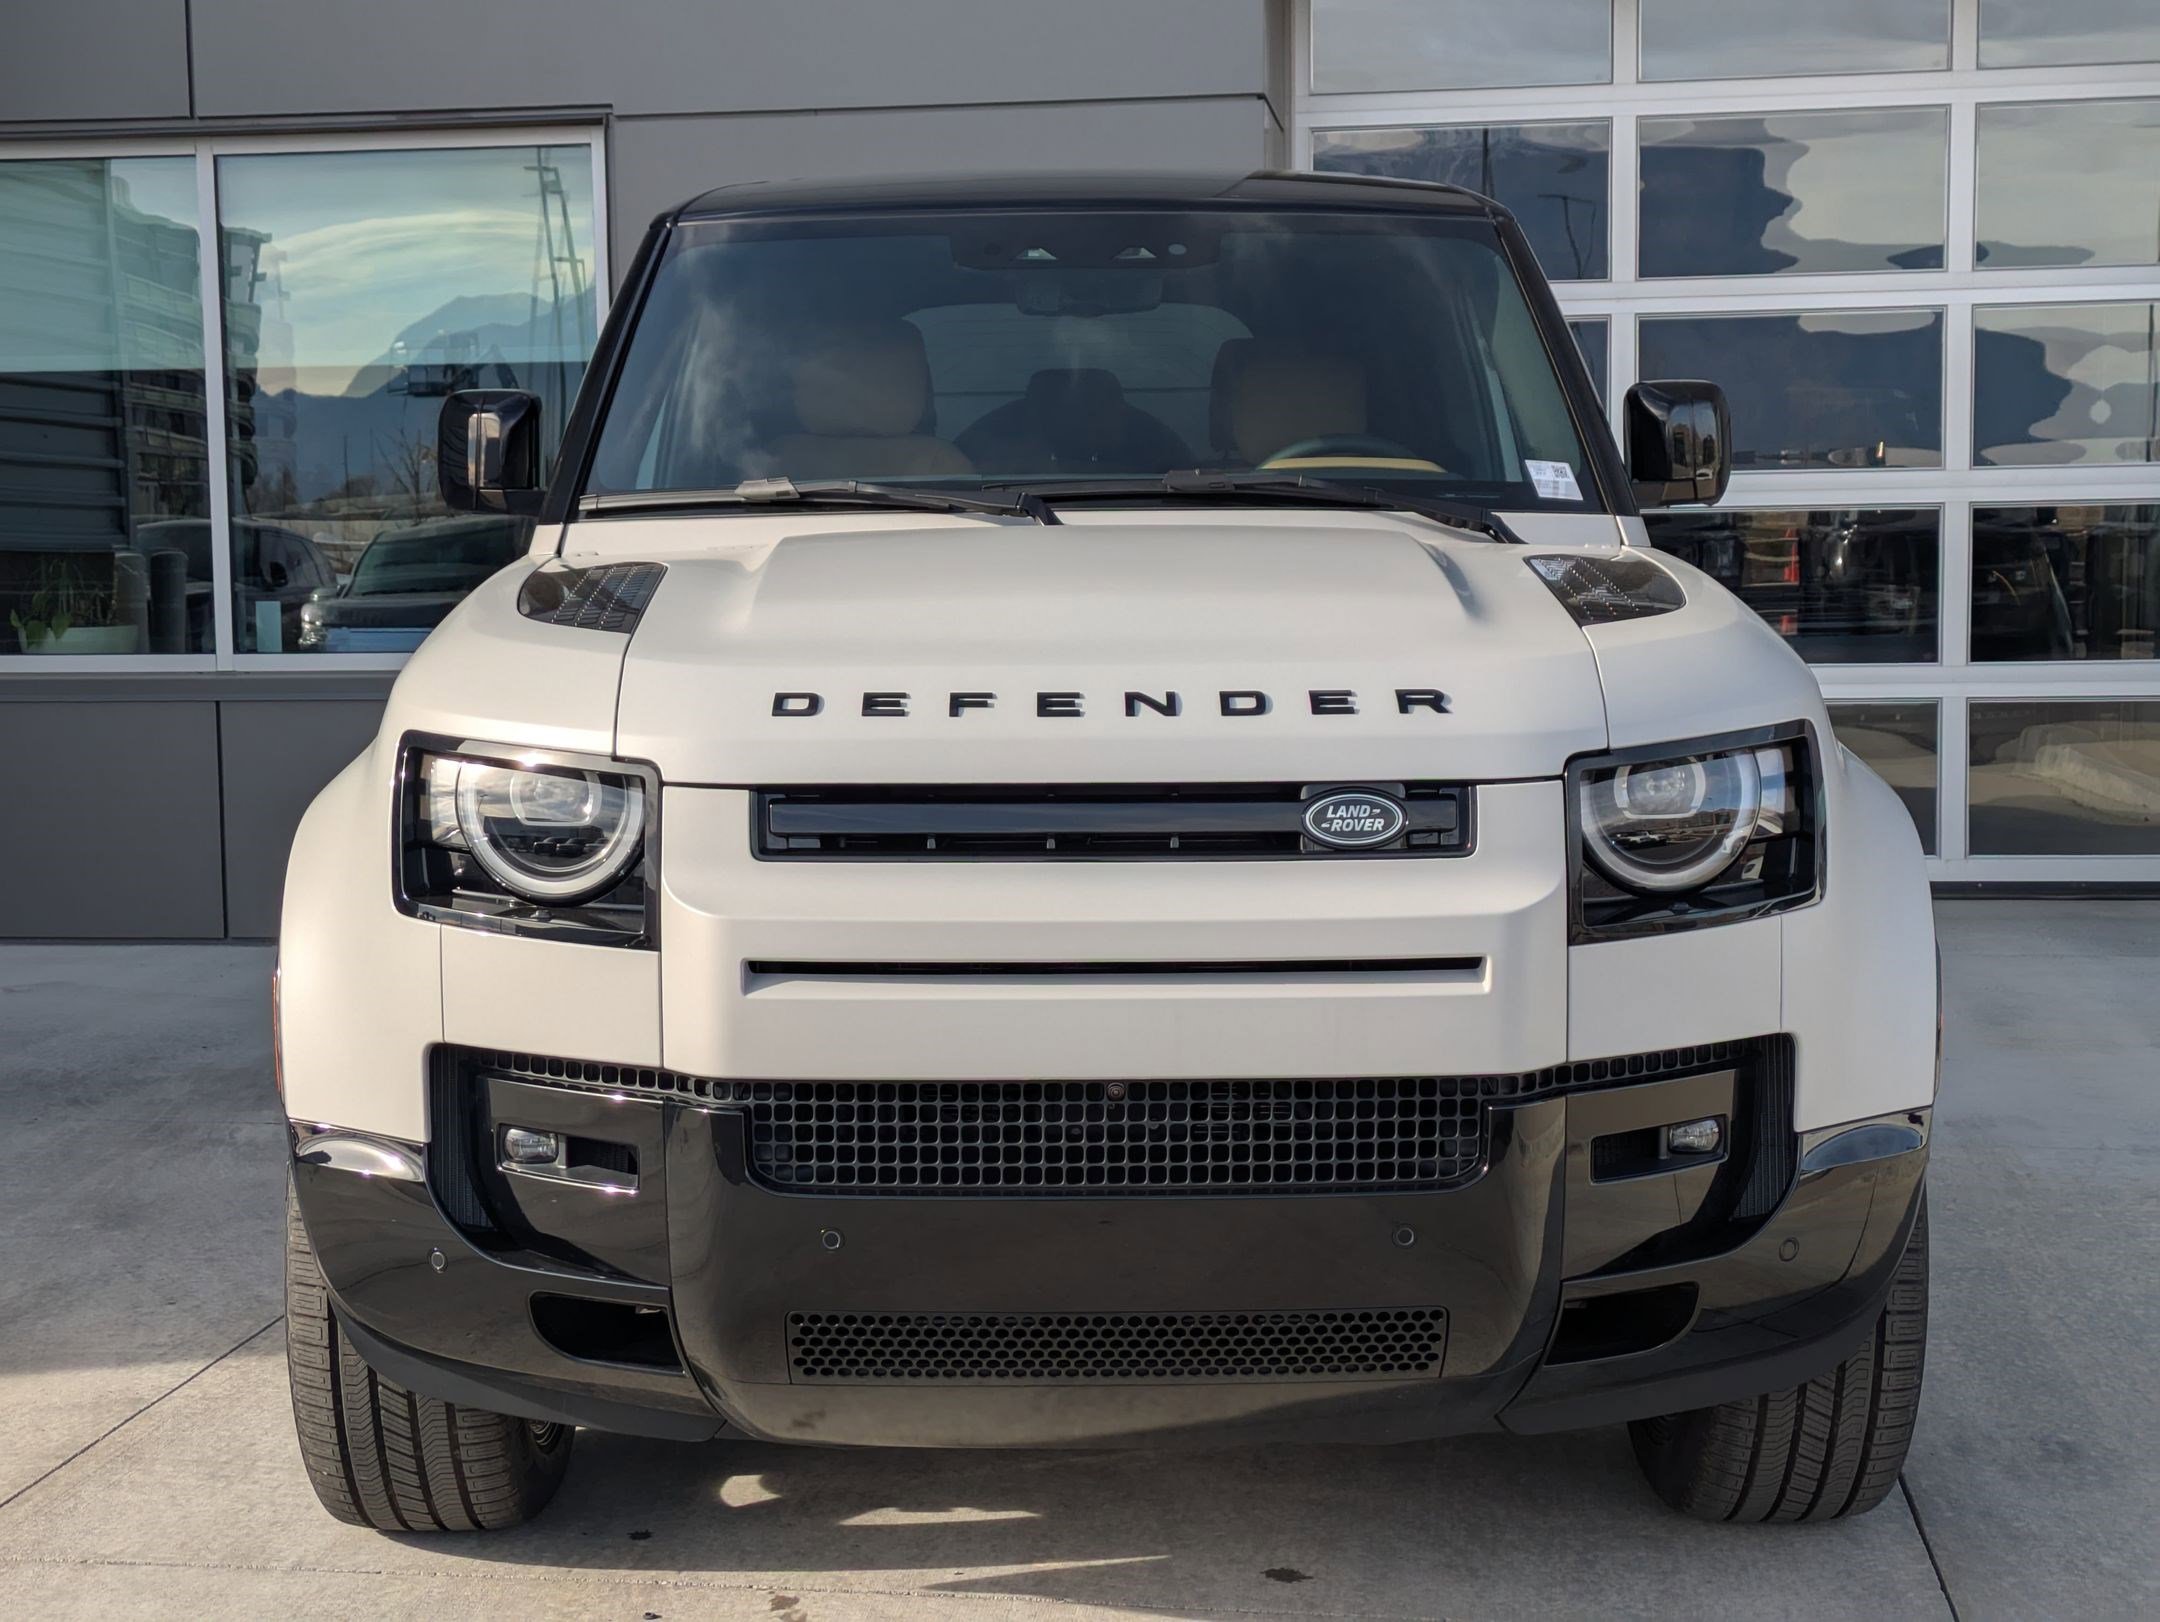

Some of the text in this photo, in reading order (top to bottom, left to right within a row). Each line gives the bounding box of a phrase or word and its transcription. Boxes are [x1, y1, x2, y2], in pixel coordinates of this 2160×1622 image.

[772, 689, 1451, 717] DEFENDER
[1326, 804, 1371, 818] LAND
[1330, 818, 1385, 832] ROVER
